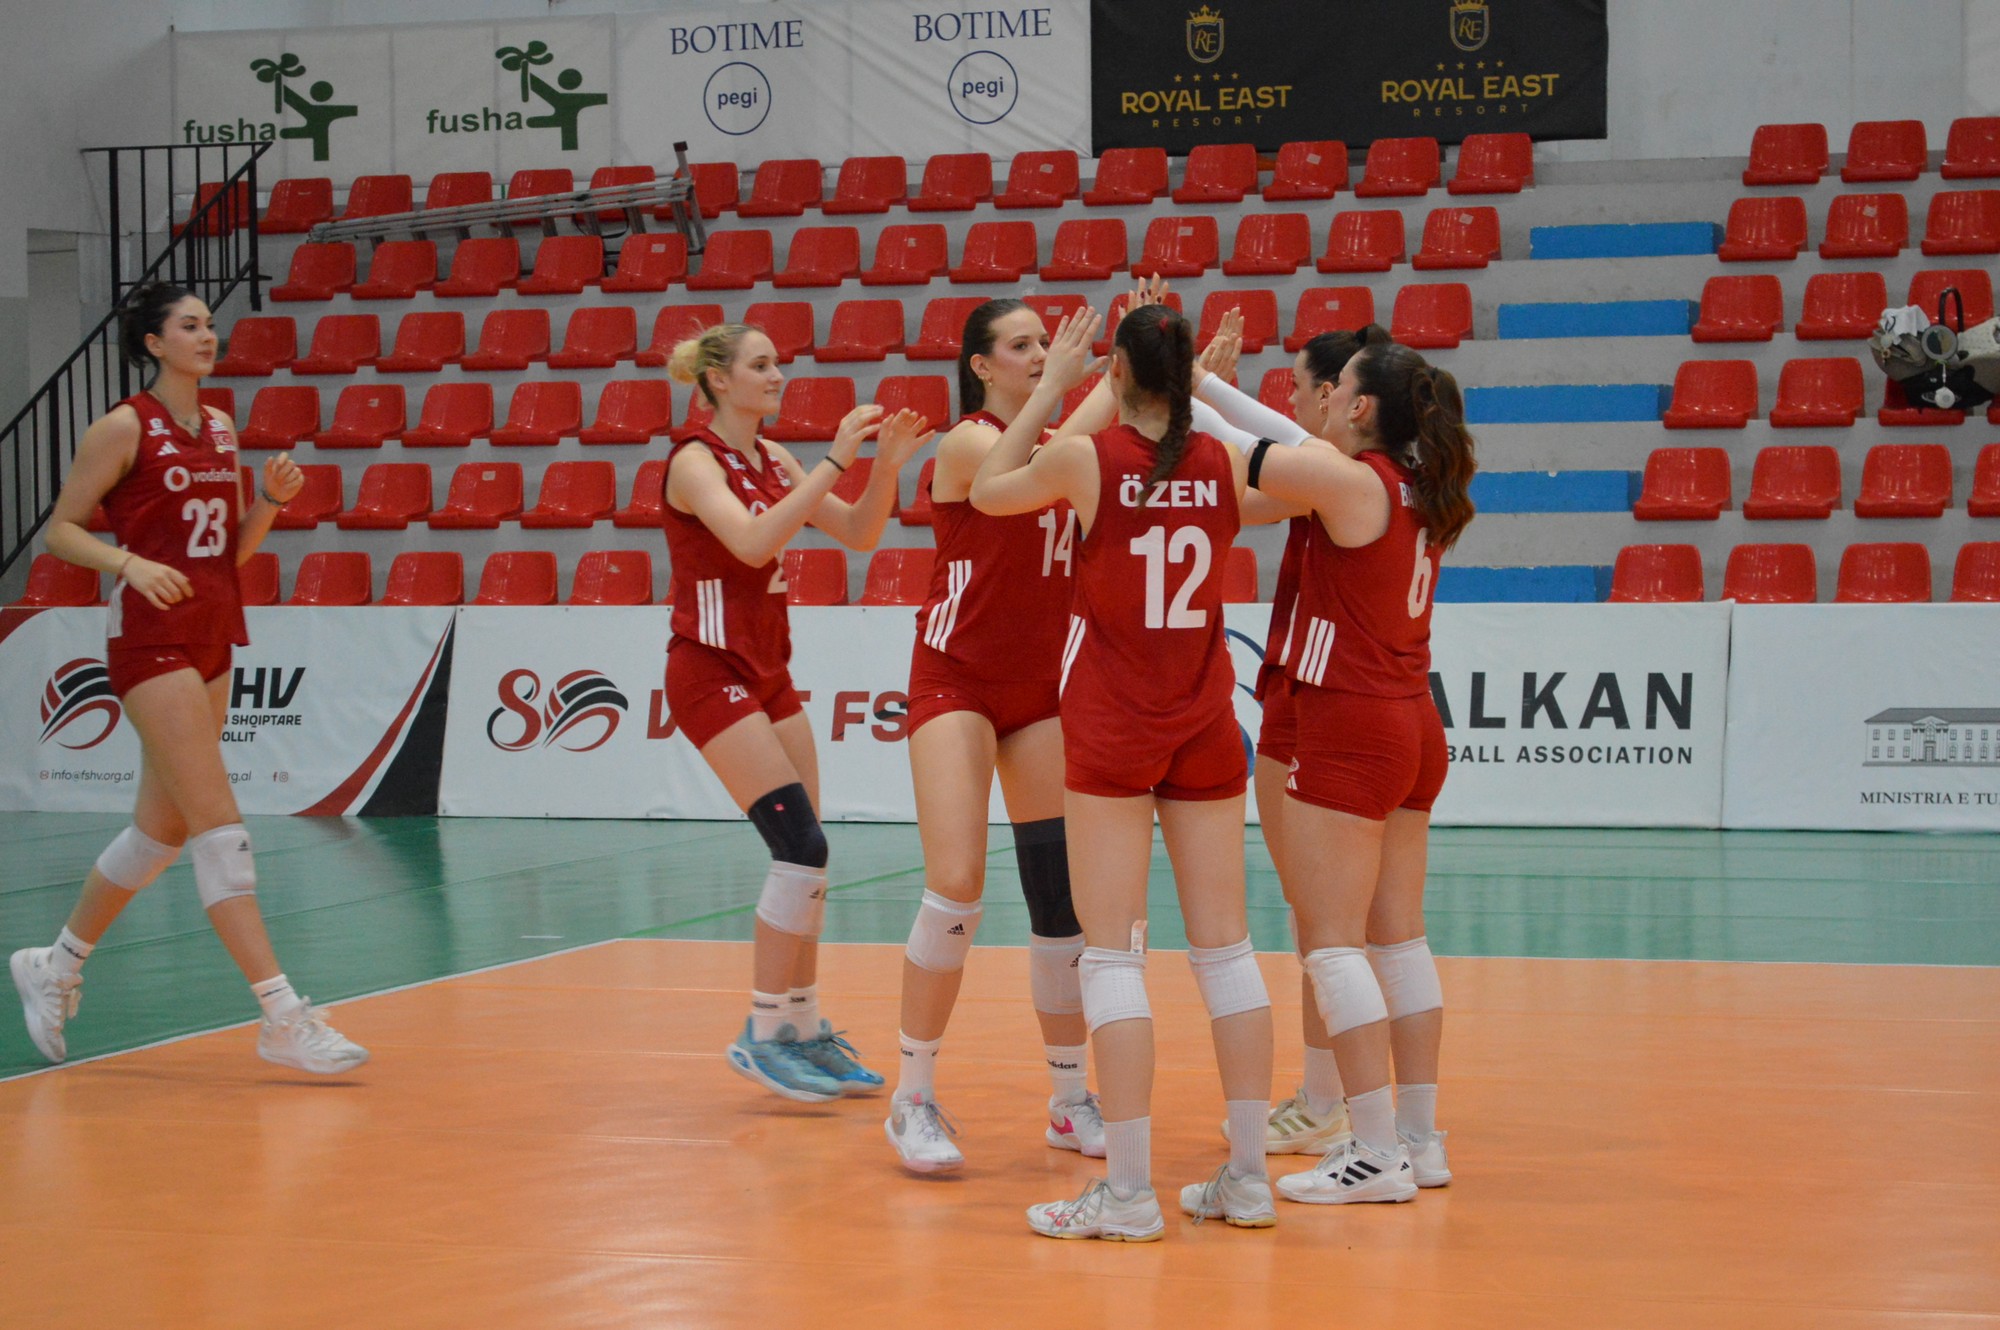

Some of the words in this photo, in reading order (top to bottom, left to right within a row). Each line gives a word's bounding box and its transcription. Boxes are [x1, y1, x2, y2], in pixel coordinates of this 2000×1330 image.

[669, 20, 804, 55] BOTIME
[913, 8, 1053, 42] BOTIME
[717, 88, 758, 110] pegi
[962, 76, 1005, 98] pegi
[1121, 87, 1211, 114] ROYAL
[1219, 85, 1292, 109] EAST
[1382, 76, 1472, 103] ROYAL
[1484, 73, 1560, 99] EAST
[426, 107, 523, 134] fusha
[1152, 115, 1262, 128] RESORT
[1413, 103, 1528, 117] RESORT
[183, 118, 276, 143] fusha
[191, 467, 238, 482] vodafon
[1119, 474, 1218, 507] ÖZEN
[182, 498, 228, 558] 23
[1038, 508, 1076, 577] 14
[1130, 525, 1212, 628] 12
[1407, 527, 1432, 619] 6
[230, 667, 306, 709] HV
[1428, 671, 1693, 730] LKAN
[231, 714, 302, 728] SHQIPTARE
[831, 691, 908, 742] FS
[220, 731, 256, 742] OLLIT
[1447, 745, 1505, 763] BALL
[1516, 745, 1693, 764] ASSOCIATION
[51, 769, 134, 783] info@fshv.org.al
[227, 770, 252, 783] rg.al
[1860, 792, 1953, 804] MINISTRIA
[1957, 792, 1969, 805] E
[1974, 792, 2000, 805] TU
